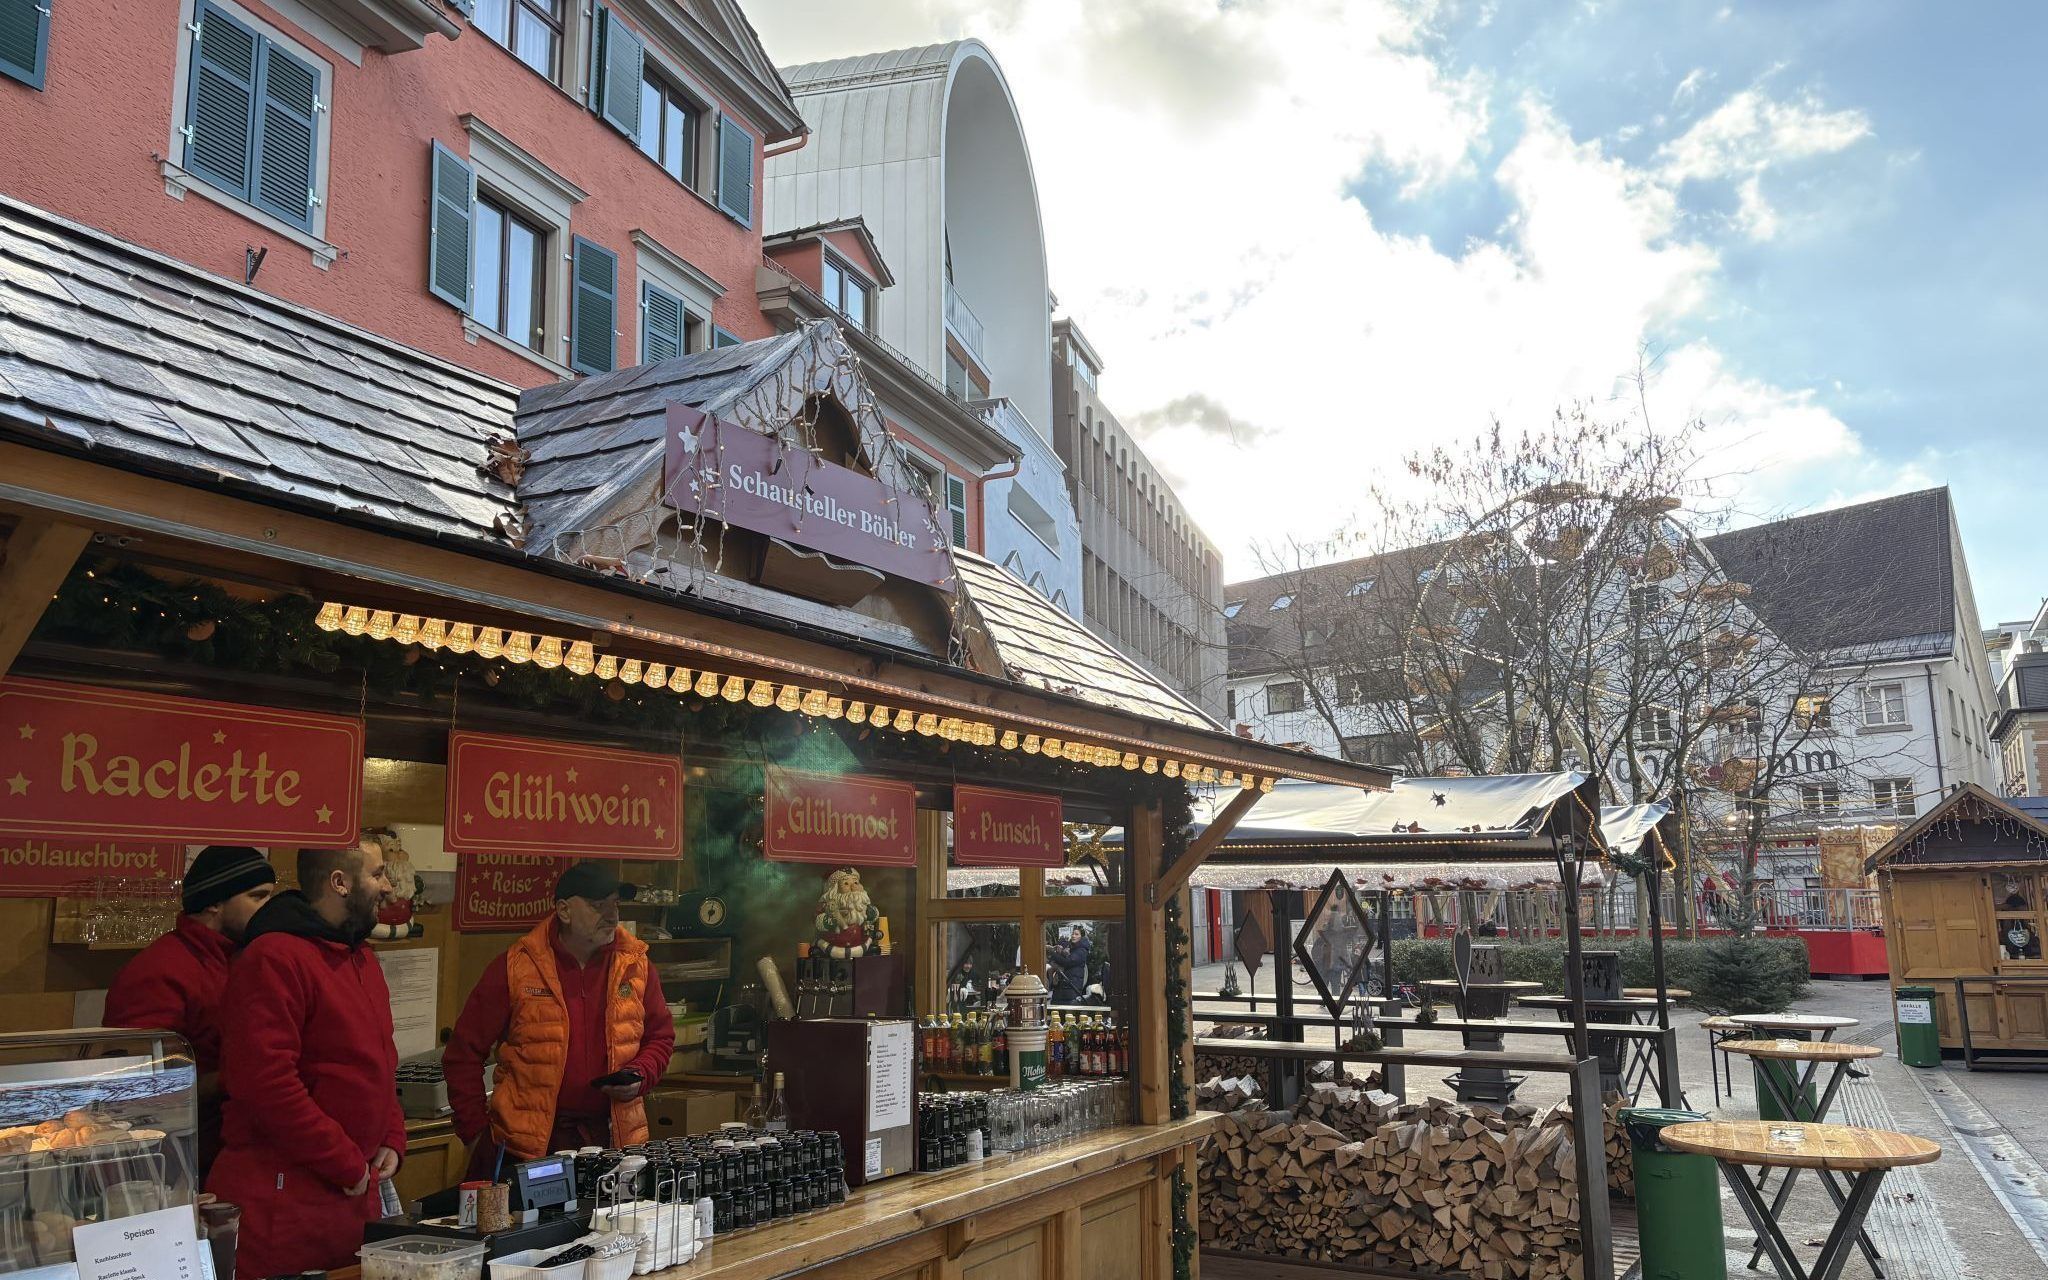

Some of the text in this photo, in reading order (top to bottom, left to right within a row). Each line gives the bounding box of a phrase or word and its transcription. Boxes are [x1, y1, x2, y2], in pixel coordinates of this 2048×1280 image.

[729, 464, 916, 549] Schausteller Böhler
[60, 732, 302, 807] Raclette
[484, 771, 651, 827] Glühwein
[787, 796, 898, 840] Glühmost
[980, 811, 1041, 845] Punsch
[492, 871, 540, 893] Reise-
[123, 1227, 155, 1241] Speisen
